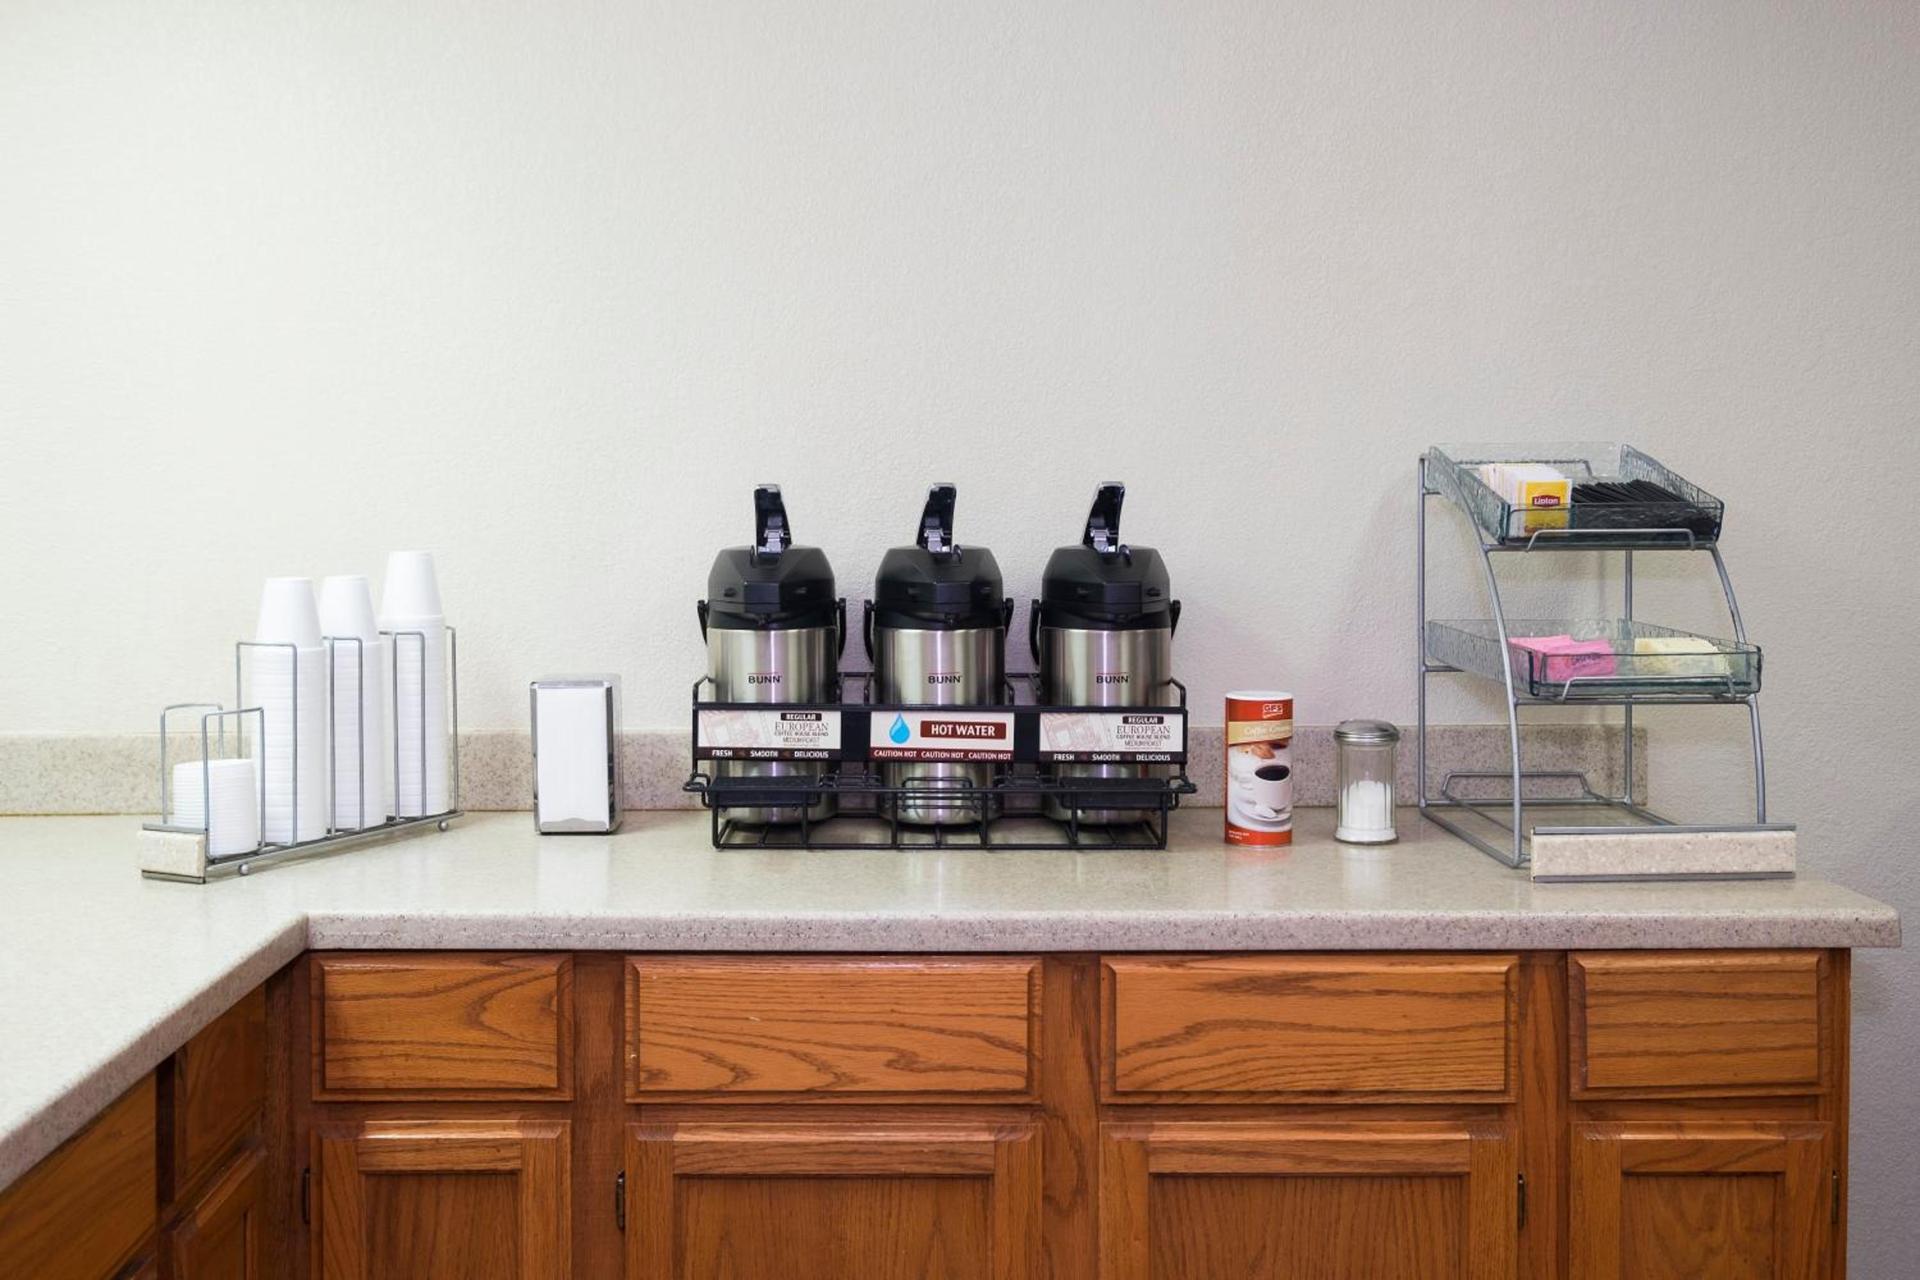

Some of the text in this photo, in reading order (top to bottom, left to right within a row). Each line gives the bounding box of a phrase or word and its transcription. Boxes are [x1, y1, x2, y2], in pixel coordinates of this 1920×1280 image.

[1534, 497, 1559, 505] Lipton
[748, 675, 781, 684] BUNN
[928, 675, 961, 684] BUNN
[1096, 675, 1129, 684] BUNN
[1264, 704, 1282, 712] GFS
[775, 722, 829, 731] EUROPEAN
[931, 724, 996, 737] HOT WATER
[1116, 725, 1171, 734] EUROPEAN
[874, 749, 903, 757] CAUTION
